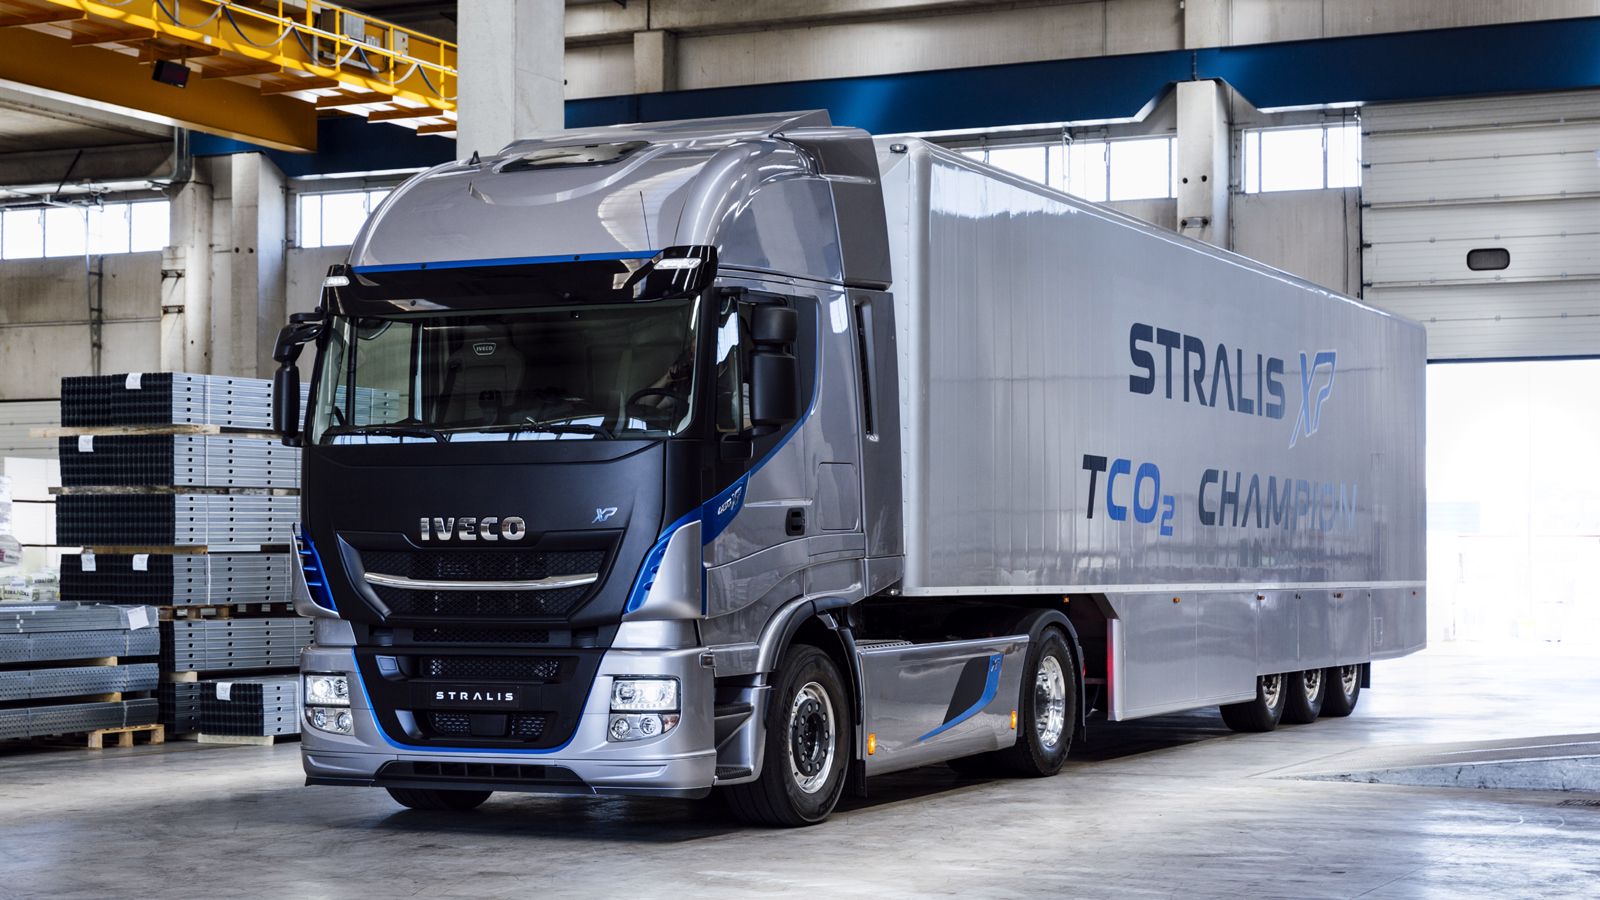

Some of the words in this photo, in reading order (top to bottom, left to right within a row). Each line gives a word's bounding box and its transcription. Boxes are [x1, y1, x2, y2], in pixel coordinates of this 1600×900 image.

[1129, 322, 1286, 420] STRALIS
[1288, 348, 1337, 449] XP
[1198, 468, 1358, 533] CHAMPION
[591, 506, 618, 524] XP
[420, 516, 526, 541] IVECO
[435, 691, 514, 701] STRALIS
